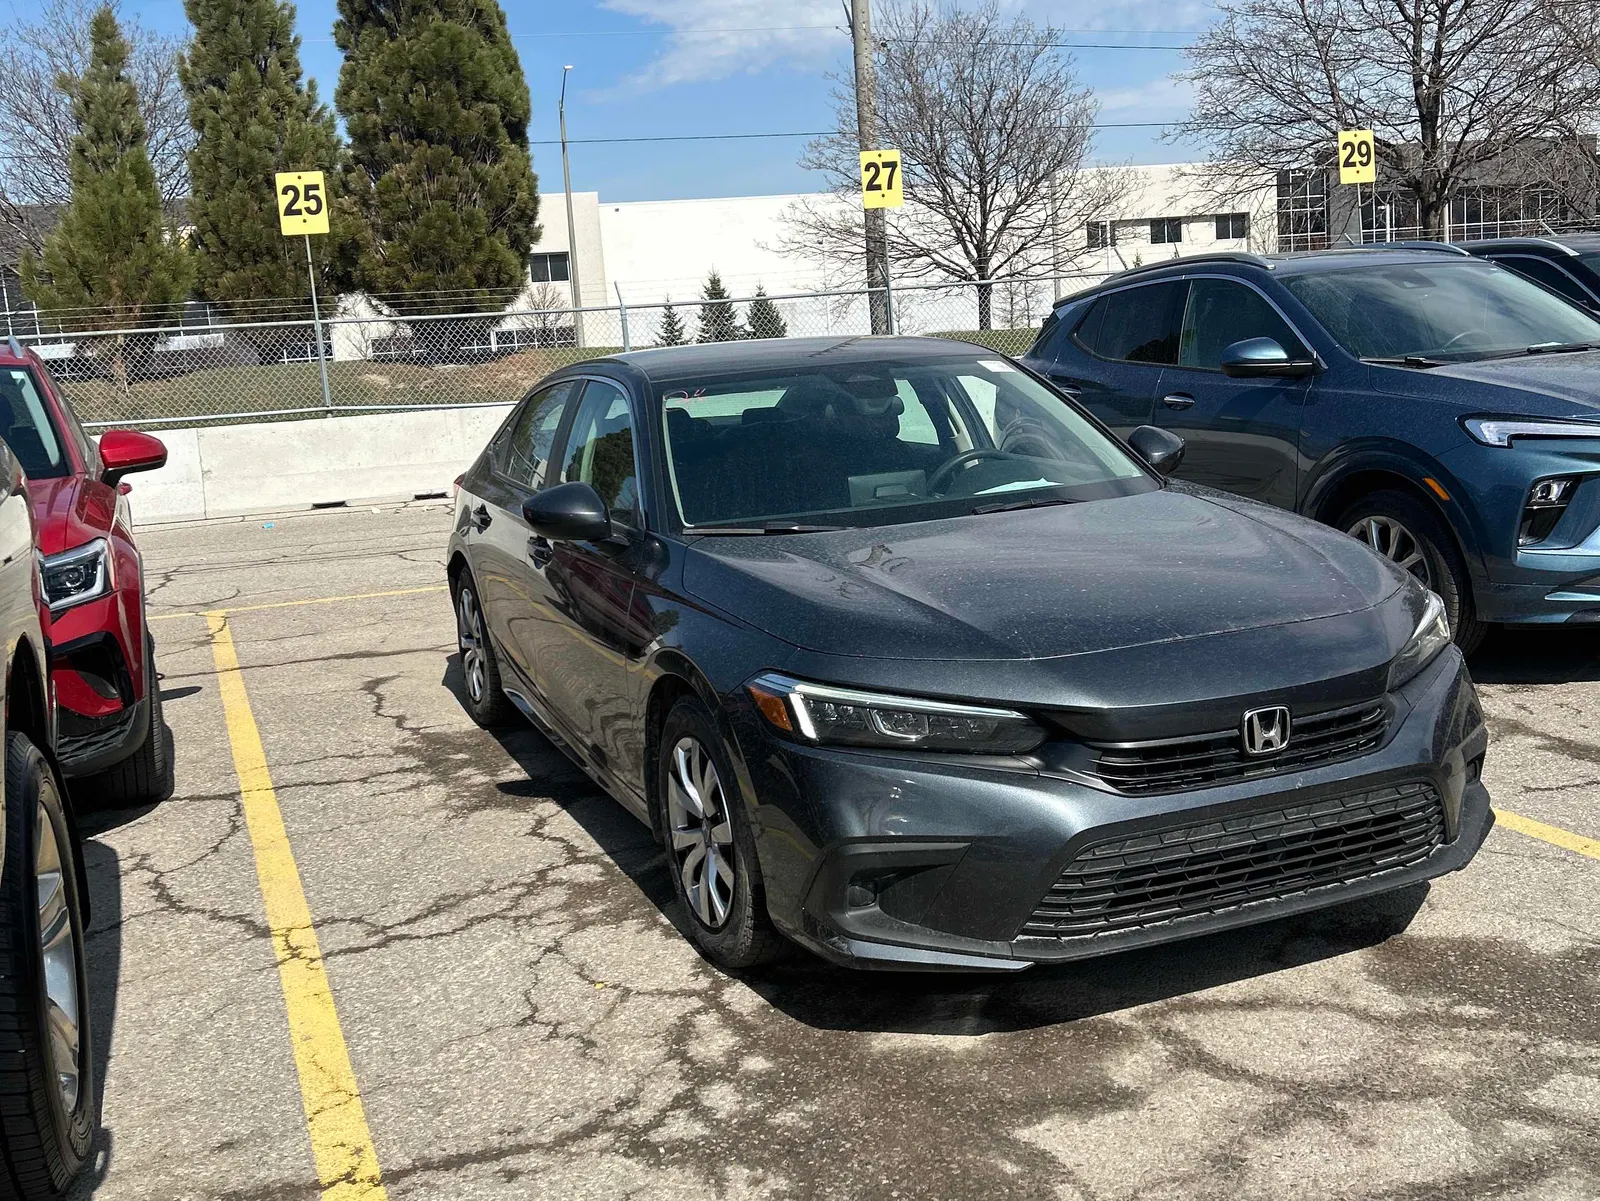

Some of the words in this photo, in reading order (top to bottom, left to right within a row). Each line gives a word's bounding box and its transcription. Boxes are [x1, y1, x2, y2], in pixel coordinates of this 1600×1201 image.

[1341, 140, 1372, 168] 29
[864, 160, 898, 192] 27
[281, 183, 323, 217] 25
